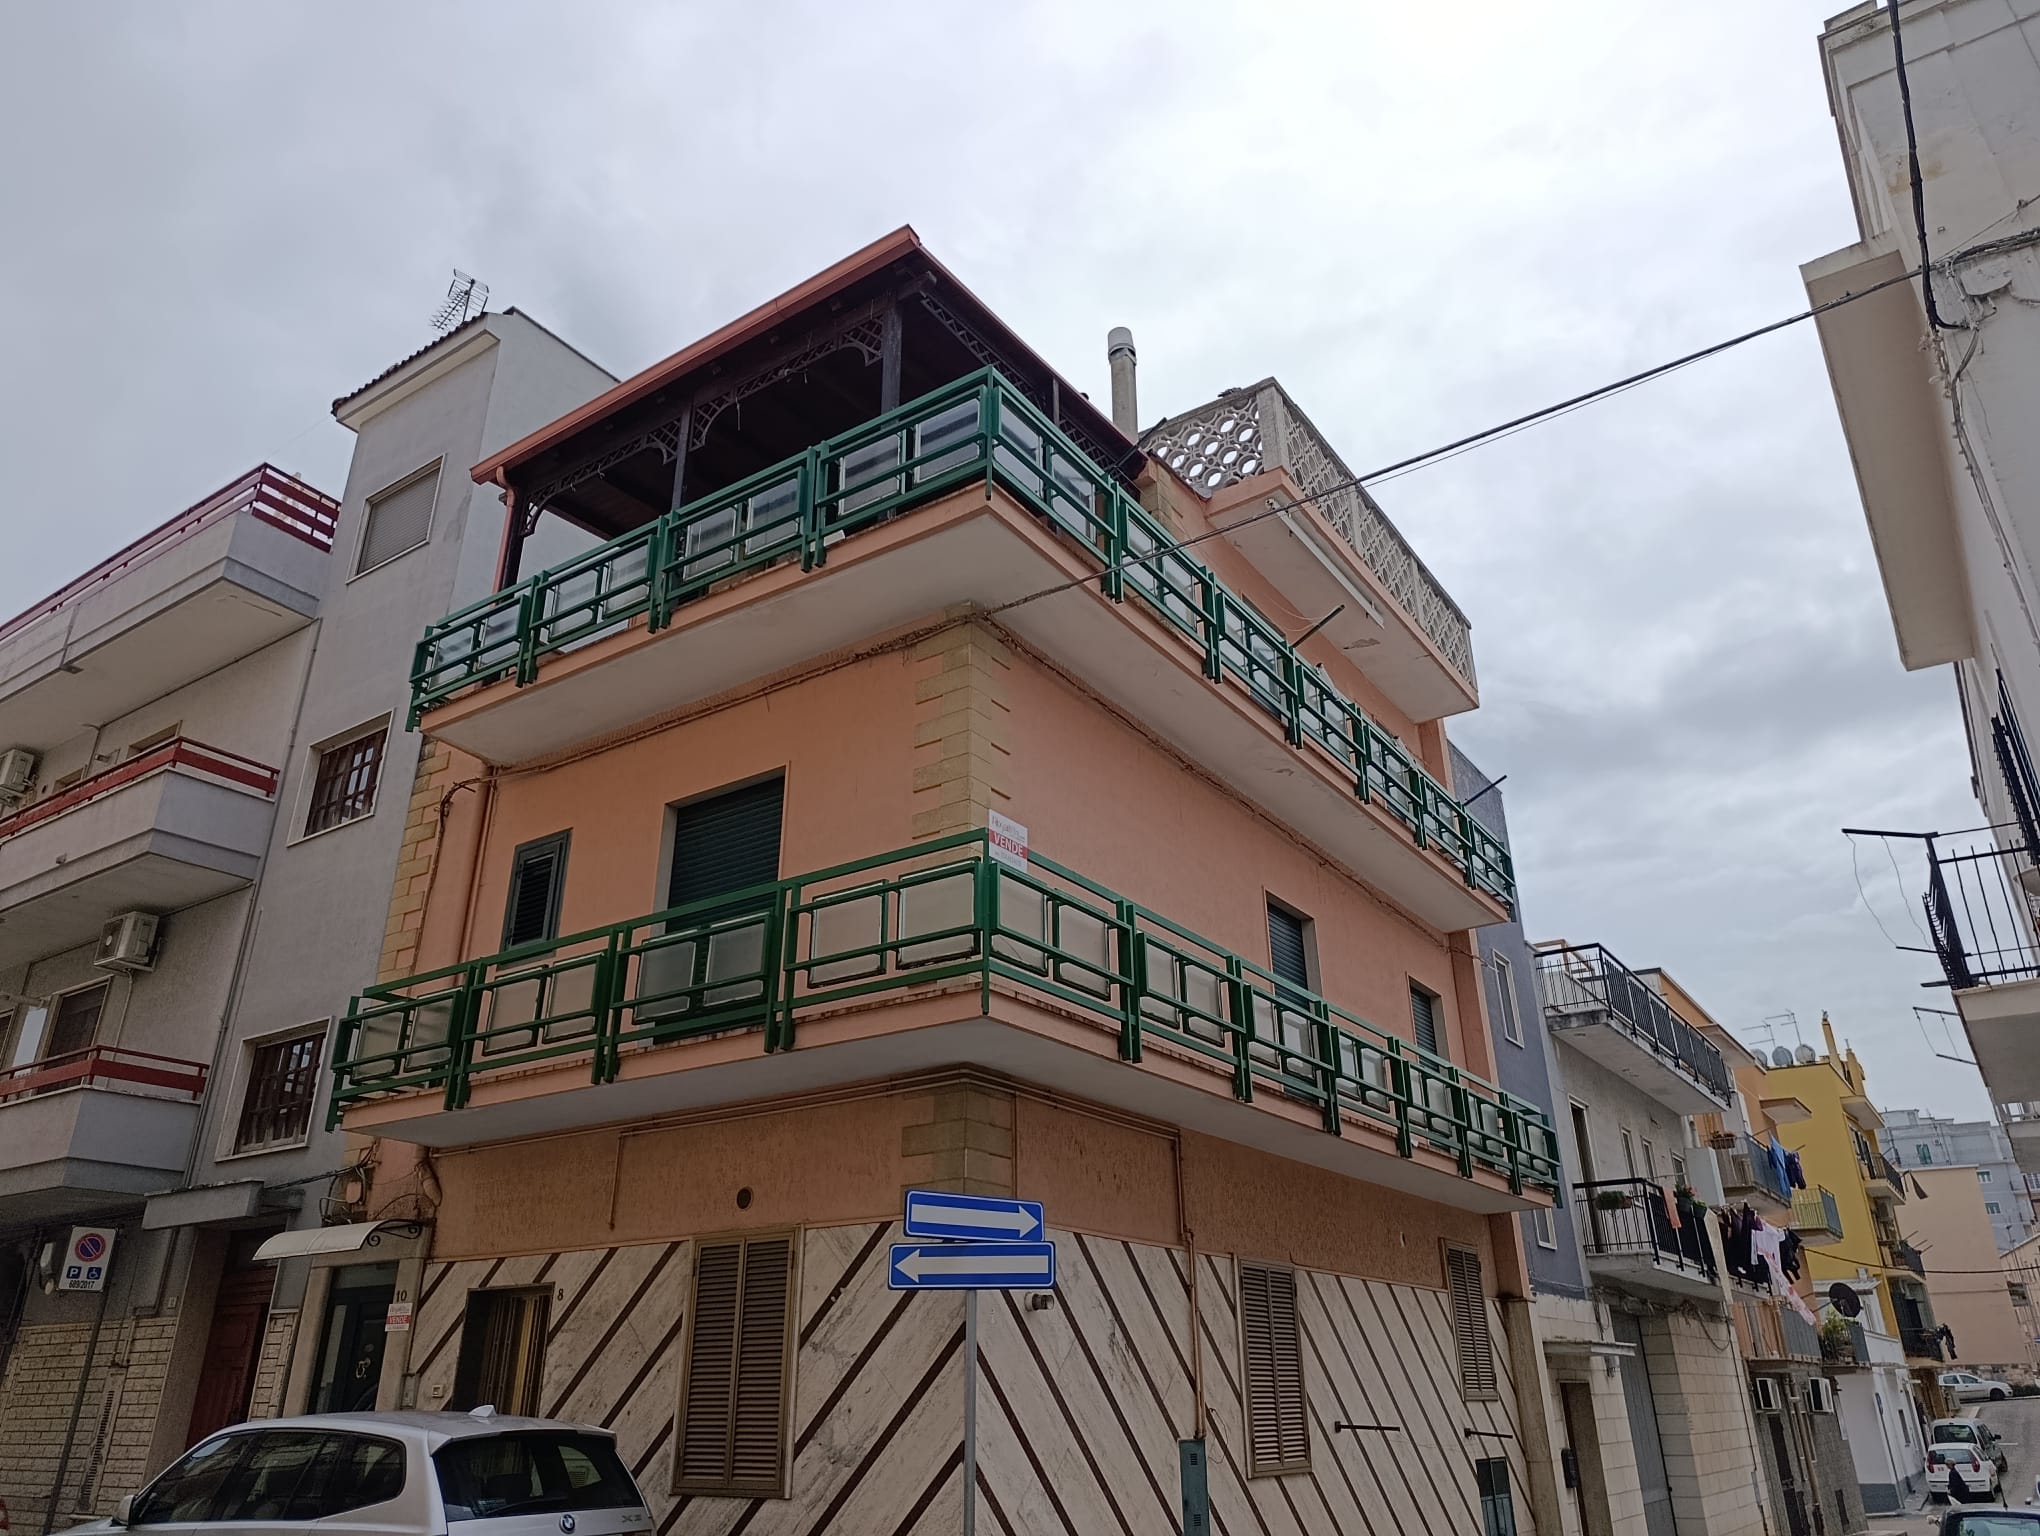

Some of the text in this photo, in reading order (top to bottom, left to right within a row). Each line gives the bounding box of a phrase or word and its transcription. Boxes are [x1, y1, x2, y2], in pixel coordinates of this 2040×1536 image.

[994, 832, 1024, 857] VENDE
[69, 1267, 79, 1278] P
[396, 1289, 408, 1302] 10
[557, 1288, 564, 1301] 8
